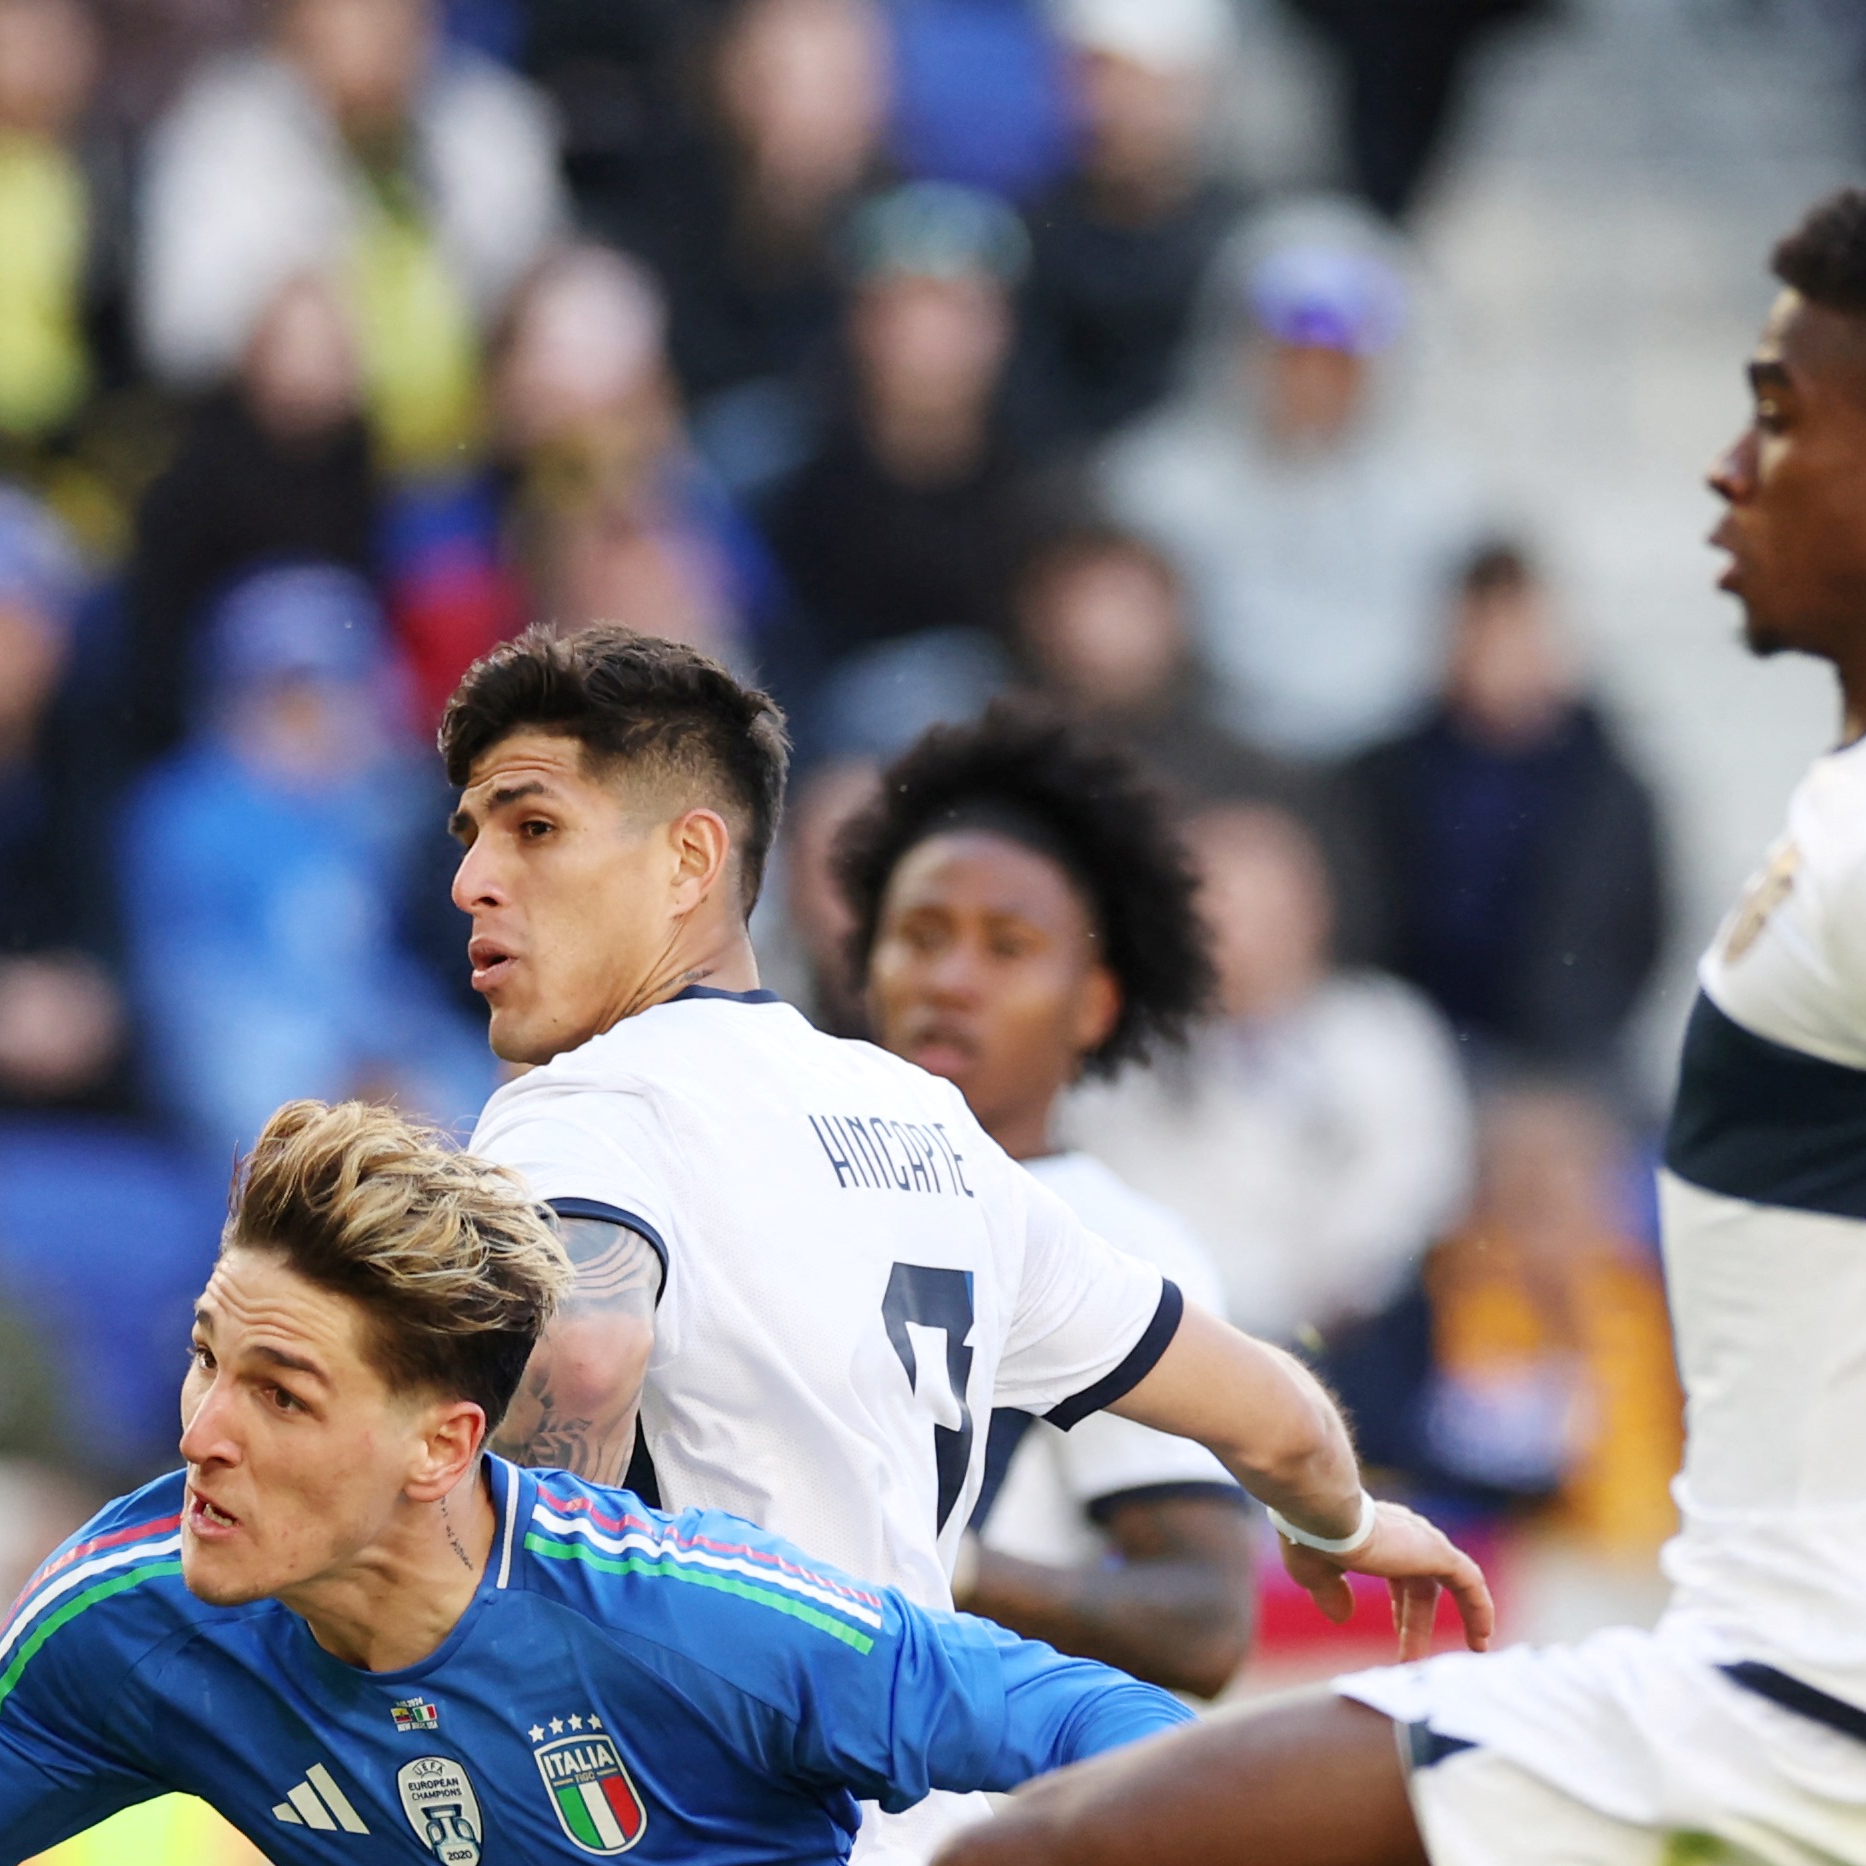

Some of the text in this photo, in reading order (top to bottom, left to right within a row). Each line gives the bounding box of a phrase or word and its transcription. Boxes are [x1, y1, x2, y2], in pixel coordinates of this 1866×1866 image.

[808, 1114, 975, 1198] HINCAPIE
[543, 1743, 615, 1779] ITALIA
[415, 1761, 444, 1776] UEFA
[408, 1777, 460, 1791] EUROPEAN
[411, 1788, 463, 1801] CHAMPIONS
[447, 1849, 473, 1861] 2020
